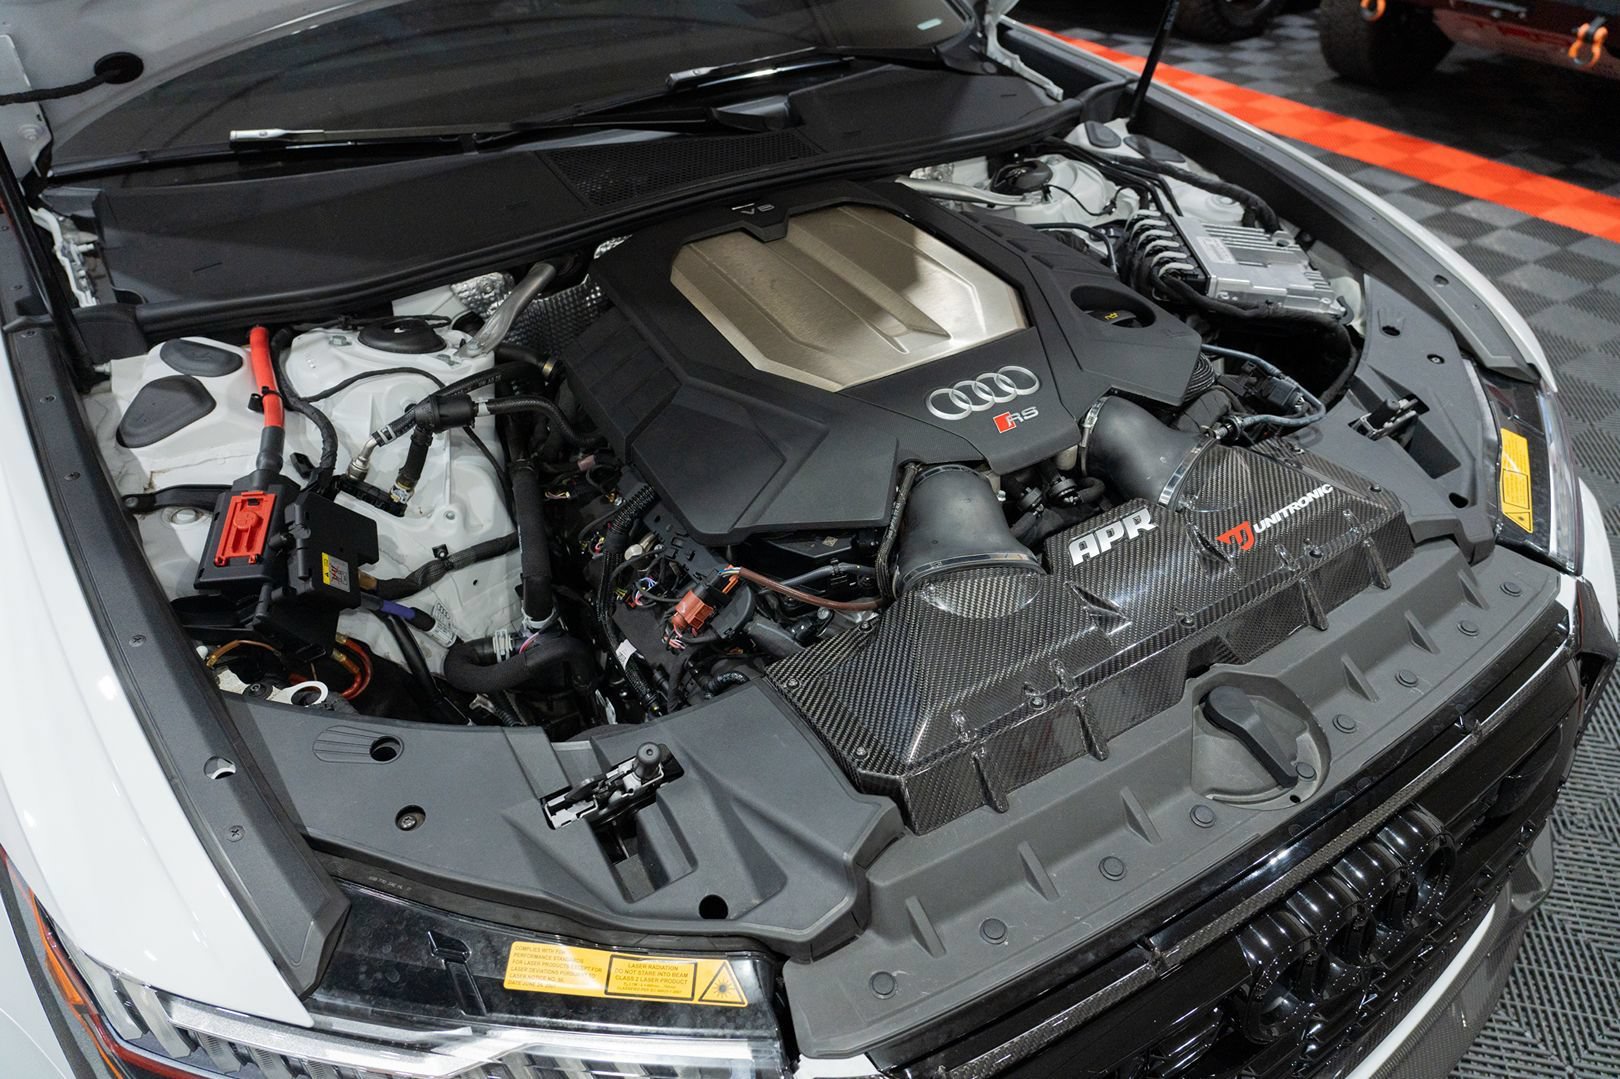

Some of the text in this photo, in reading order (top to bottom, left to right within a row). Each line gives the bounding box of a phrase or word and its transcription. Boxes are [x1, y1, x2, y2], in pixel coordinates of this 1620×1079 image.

[1000, 406, 1039, 430] RS
[1253, 484, 1334, 534] UNITRONIC
[1068, 506, 1158, 567] APR
